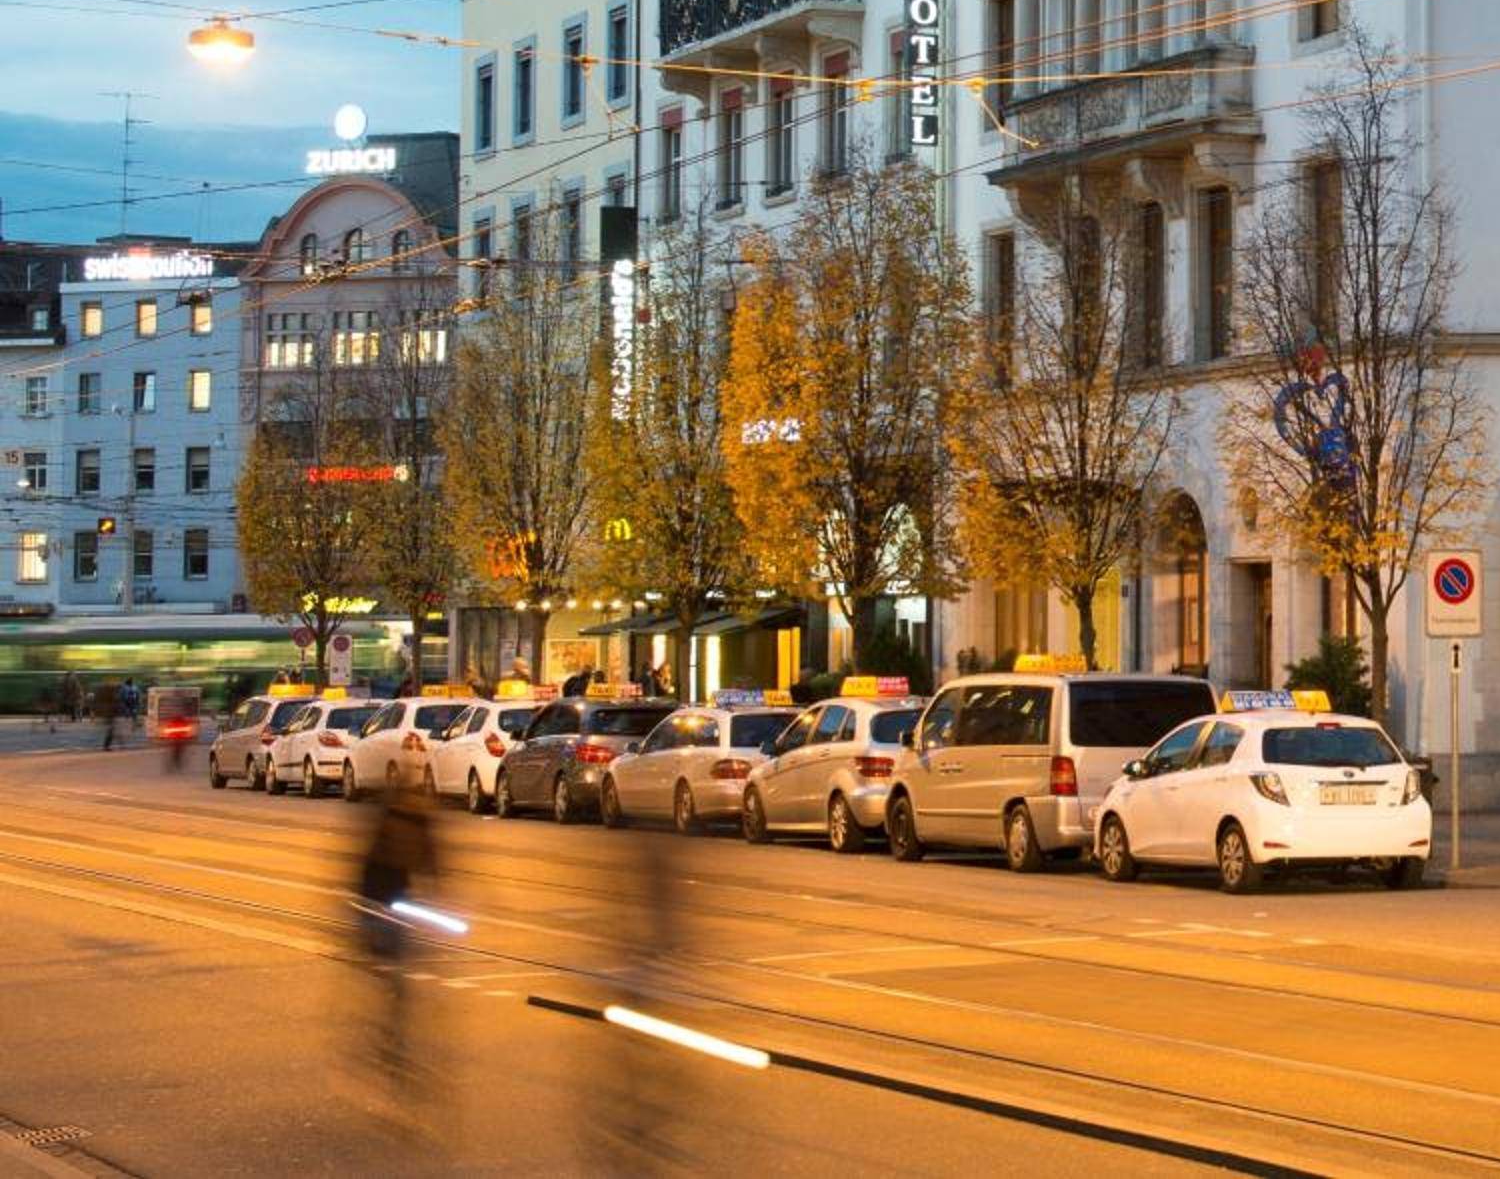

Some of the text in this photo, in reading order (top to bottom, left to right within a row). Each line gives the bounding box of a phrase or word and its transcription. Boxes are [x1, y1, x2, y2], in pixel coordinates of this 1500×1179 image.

[305, 148, 396, 173] ZURICH
[84, 251, 214, 280] swisaution
[5, 451, 19, 464] 15
